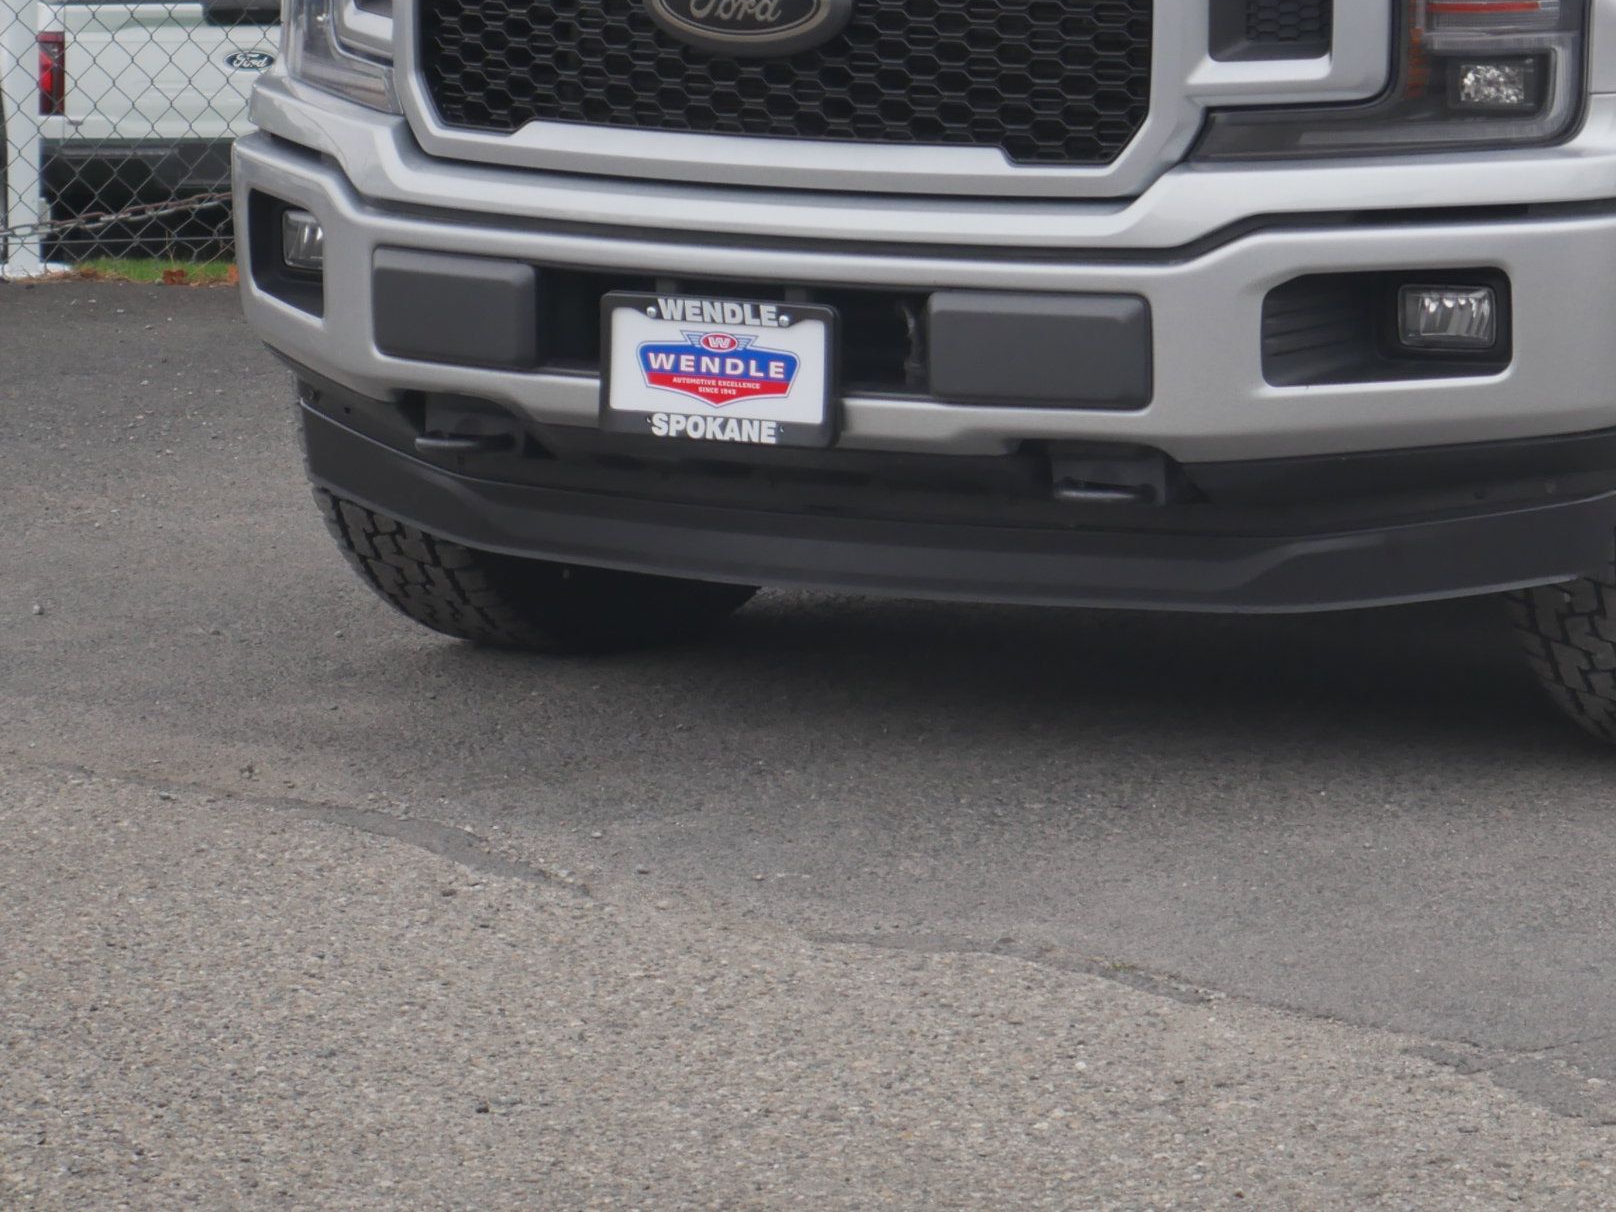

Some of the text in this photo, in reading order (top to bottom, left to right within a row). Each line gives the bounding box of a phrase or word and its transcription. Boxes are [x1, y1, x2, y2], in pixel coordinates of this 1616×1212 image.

[232, 52, 268, 68] Ford
[657, 298, 779, 327] WENDLE
[648, 352, 785, 379] WENDLE
[672, 376, 761, 390] AUTOMOTIVE EXCELLENCE
[698, 386, 719, 394] SINCE
[651, 412, 777, 444] SPOKANE
